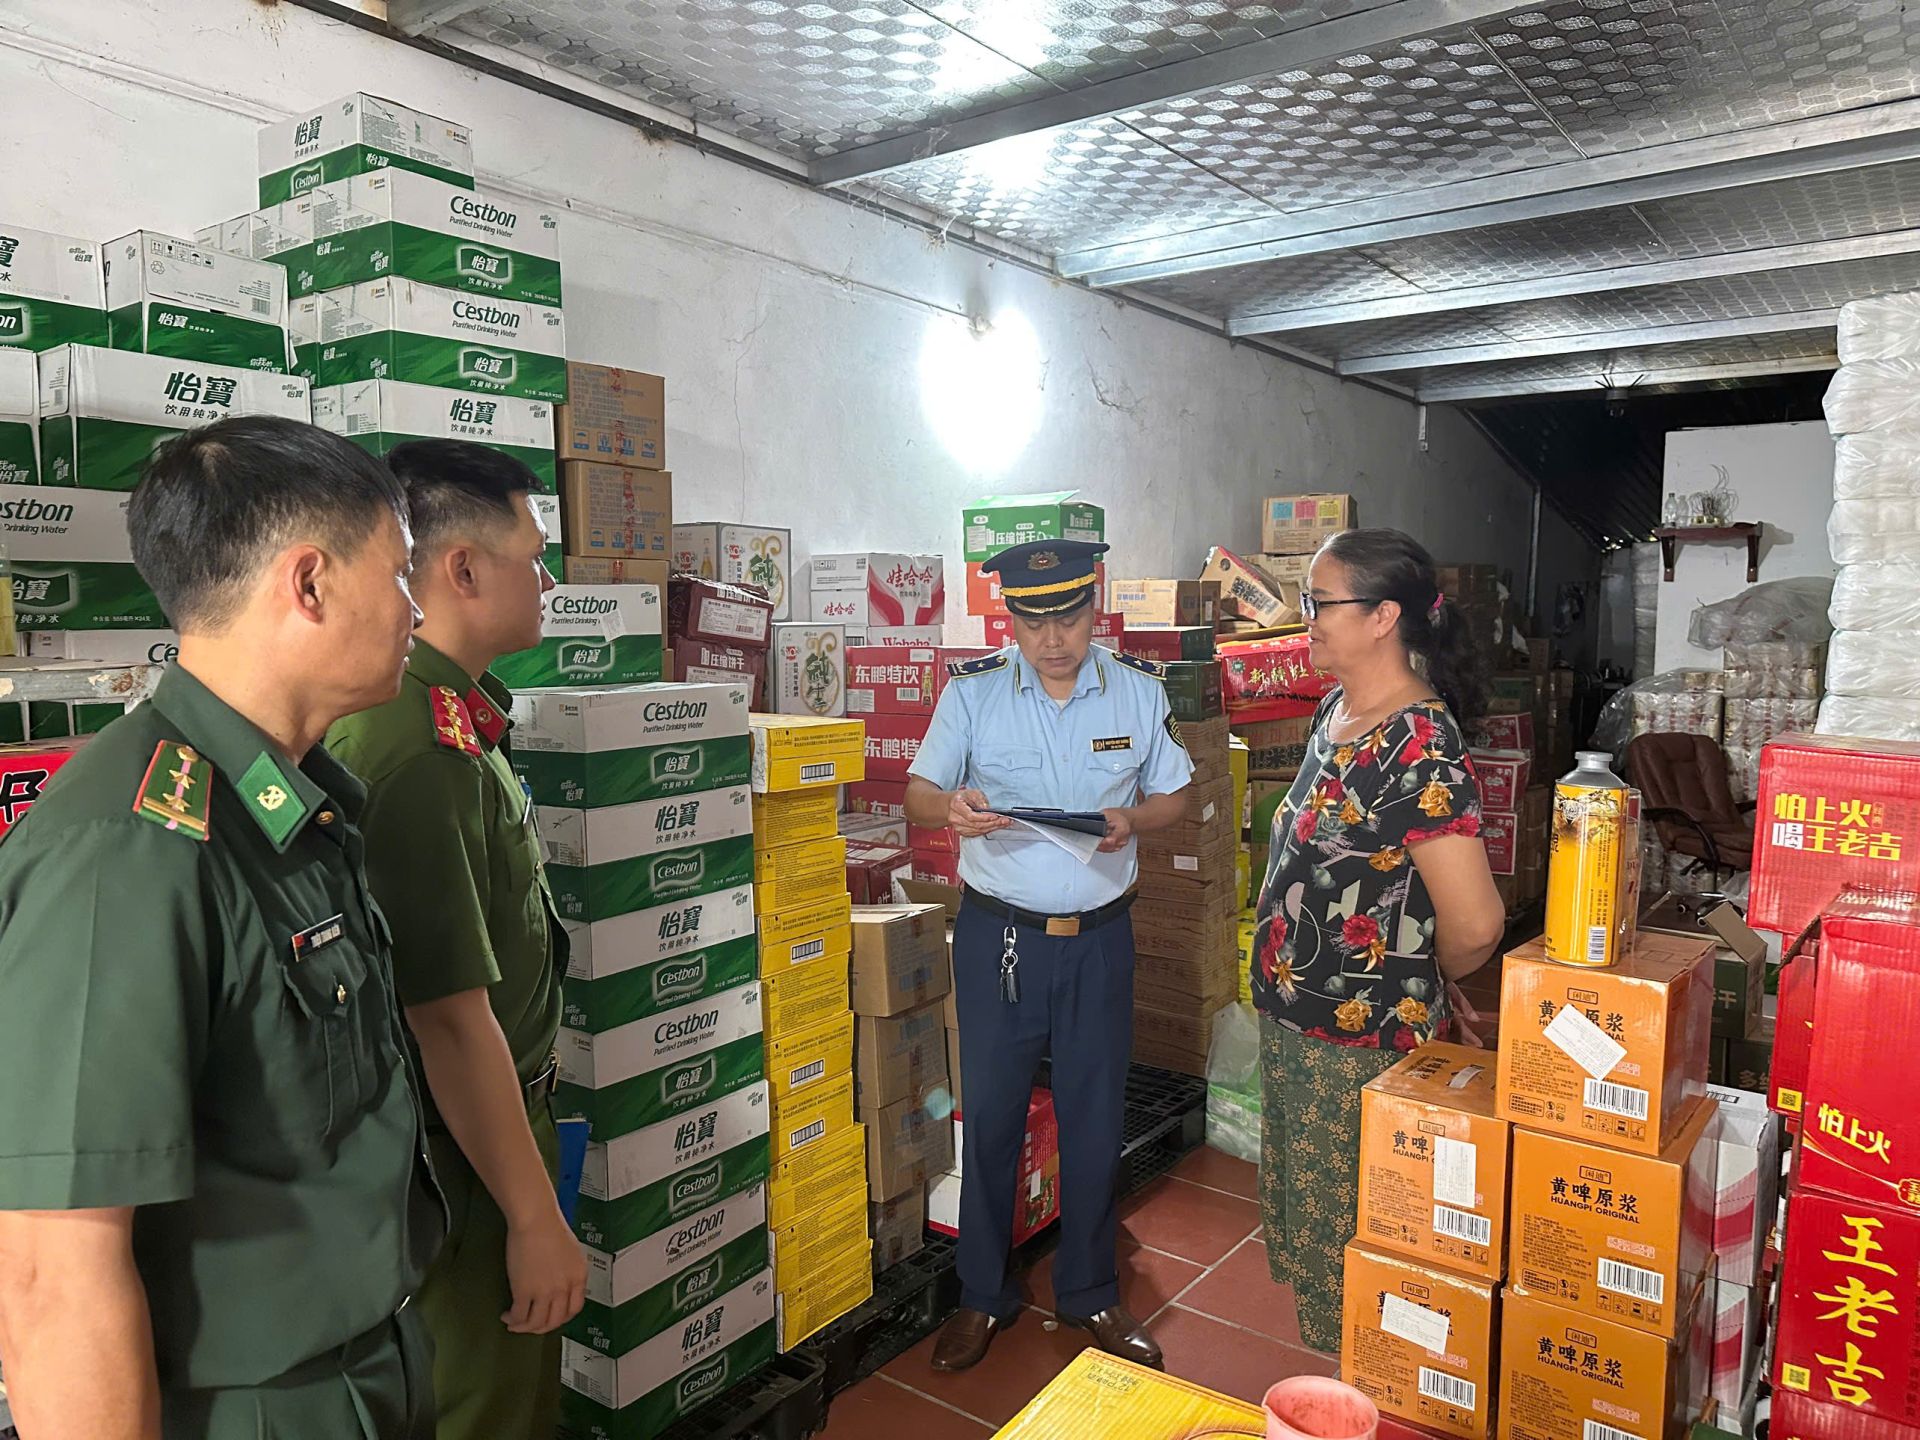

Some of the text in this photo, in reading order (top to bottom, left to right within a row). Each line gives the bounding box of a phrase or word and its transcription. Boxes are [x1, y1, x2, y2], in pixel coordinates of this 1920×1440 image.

[450, 196, 516, 228] C'estbon
[450, 216, 512, 238] Purified Drinking Water
[471, 254, 499, 274] 怡寶
[453, 300, 520, 328] C'estbon
[452, 320, 516, 338] Purified Drinking Water
[474, 356, 502, 374] 怡寶
[164, 371, 237, 407] 怡寶
[450, 398, 497, 426] 怡寶
[886, 564, 932, 588] 娃哈哈
[551, 596, 618, 614] C'estbon
[824, 602, 854, 616] 娃哈哈
[14, 614, 60, 624] 纯净水
[573, 650, 601, 664] 怡寶
[856, 665, 920, 684] 东鹏特饮
[643, 700, 708, 722] C'estbon
[642, 721, 704, 734] Purified Drinking Water
[665, 755, 690, 773] 怡寶
[655, 800, 700, 832] 怡寶
[1774, 793, 1872, 828] 怕上火
[1772, 822, 1902, 861] 喝王老吉
[658, 858, 698, 879] C'estbon
[658, 904, 702, 940] 怡寶
[660, 964, 700, 987] C'estbon
[654, 1010, 718, 1044] C'estbon
[1539, 1000, 1624, 1032] 黄原浆
[654, 1029, 716, 1056] Purified Drinking Water
[676, 1066, 702, 1090] 怡寶
[674, 1110, 718, 1152] 怡寶
[1392, 1130, 1434, 1155] 黄啤
[1817, 1102, 1892, 1164] 怕上火
[1392, 1148, 1429, 1163] HUANGPI
[676, 1170, 716, 1198] C'estbon
[1550, 1176, 1638, 1214] 黄啤原浆
[1551, 1195, 1640, 1224] HUANGPI ORIGINAL
[686, 1268, 710, 1294] 怡寶
[1814, 1214, 1898, 1407] 王老吉
[682, 1306, 724, 1350] 怡寶
[1537, 1336, 1623, 1379] 黄啤原浆
[1538, 1355, 1624, 1389] HUANGPI ORIGINAL
